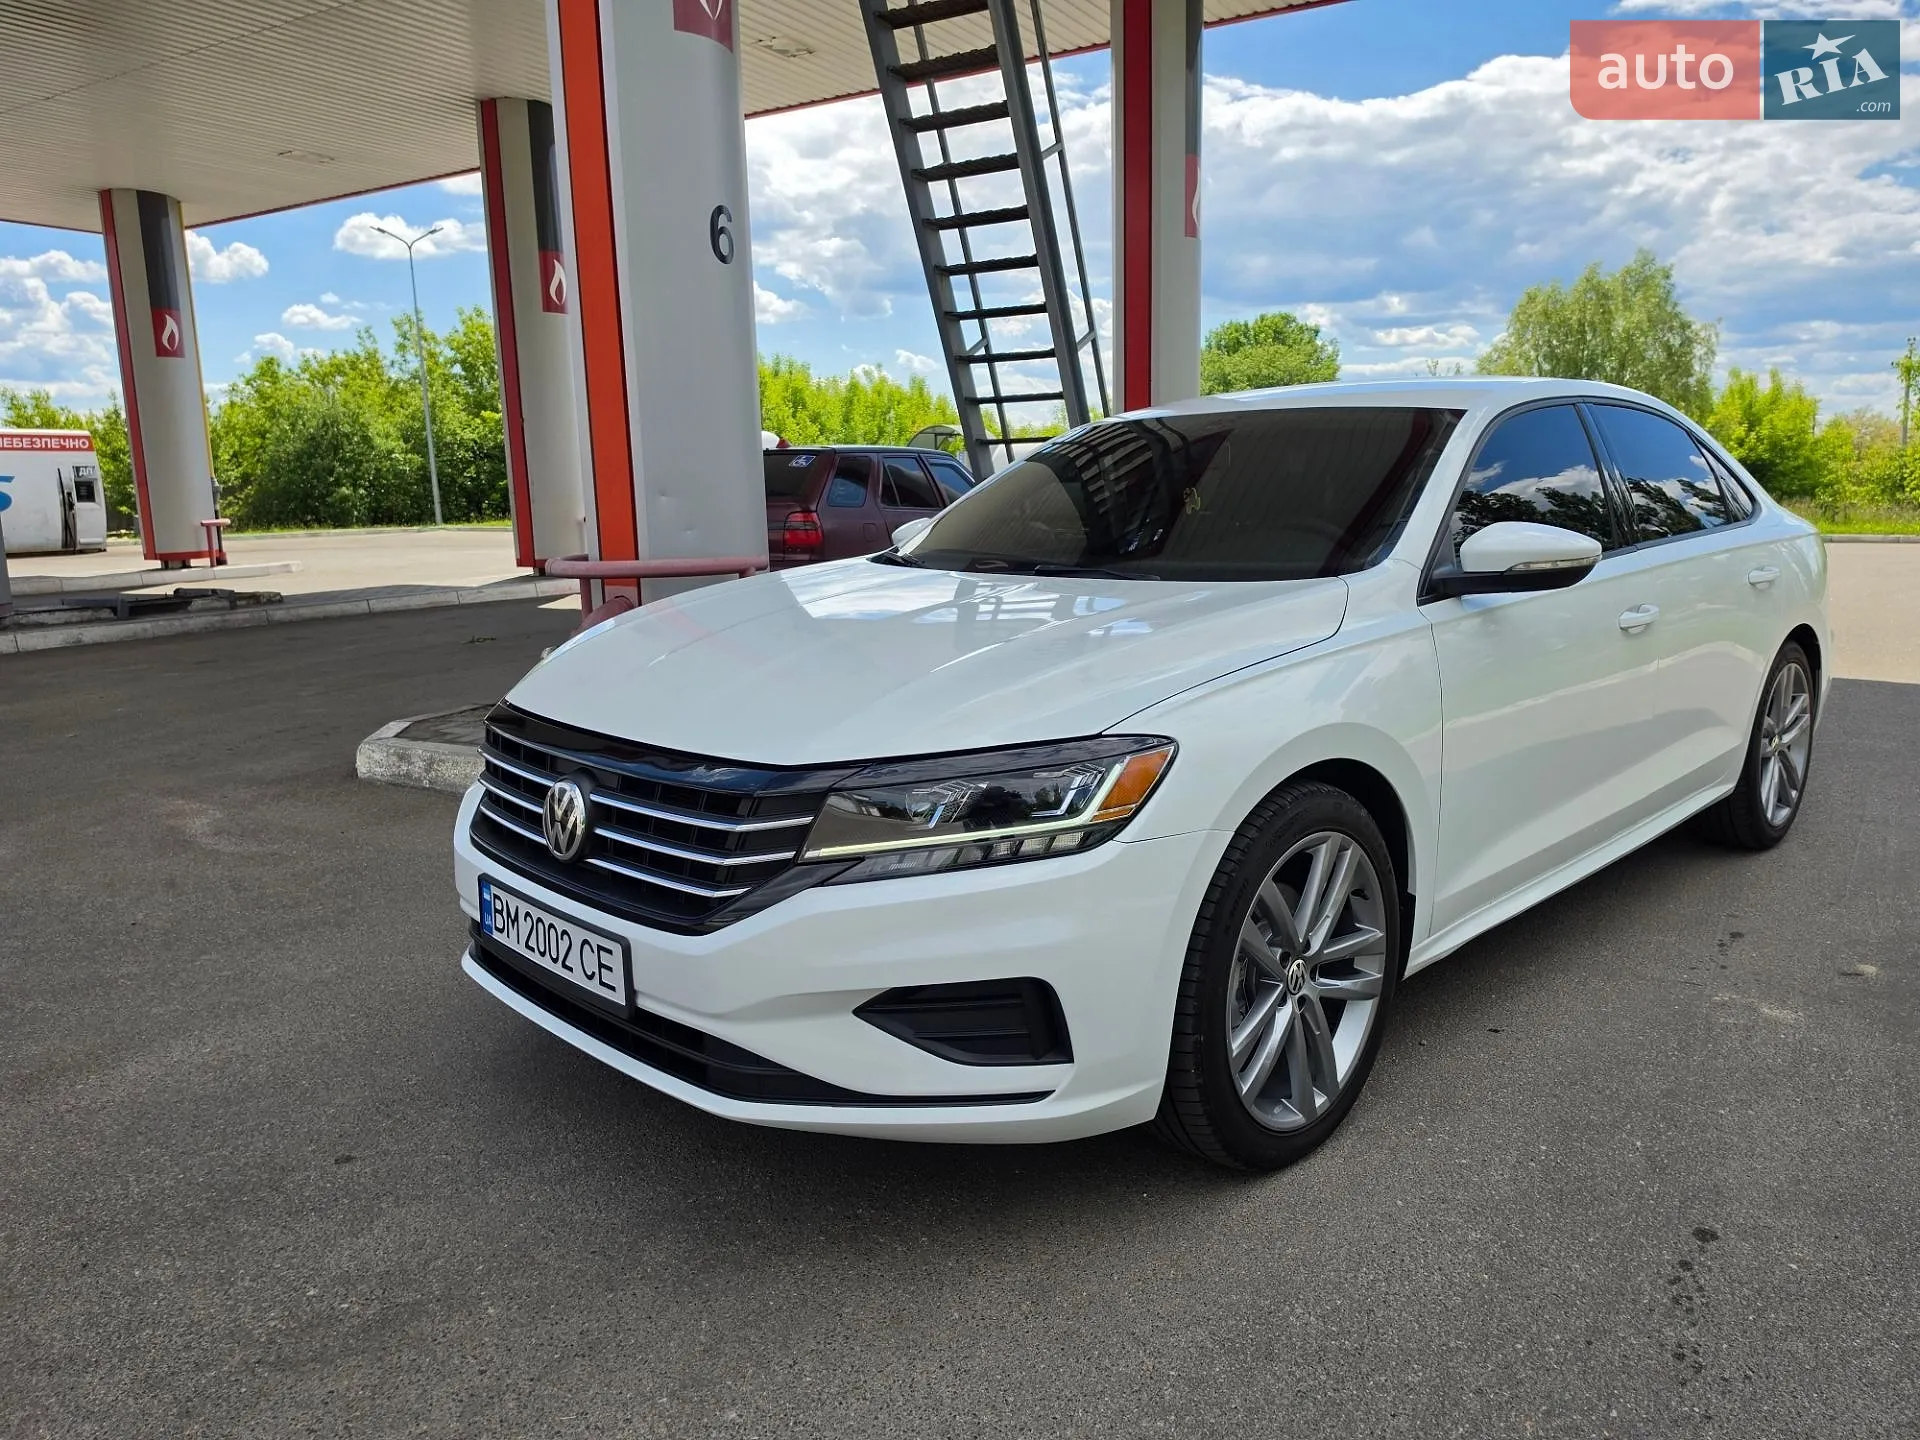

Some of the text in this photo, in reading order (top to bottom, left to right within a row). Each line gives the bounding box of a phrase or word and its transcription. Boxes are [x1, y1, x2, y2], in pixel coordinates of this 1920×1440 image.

[709, 204, 734, 265] 6
[0, 437, 89, 449] ЕБЕЗПЕЧНО
[492, 892, 616, 993] BM 2002 CE
